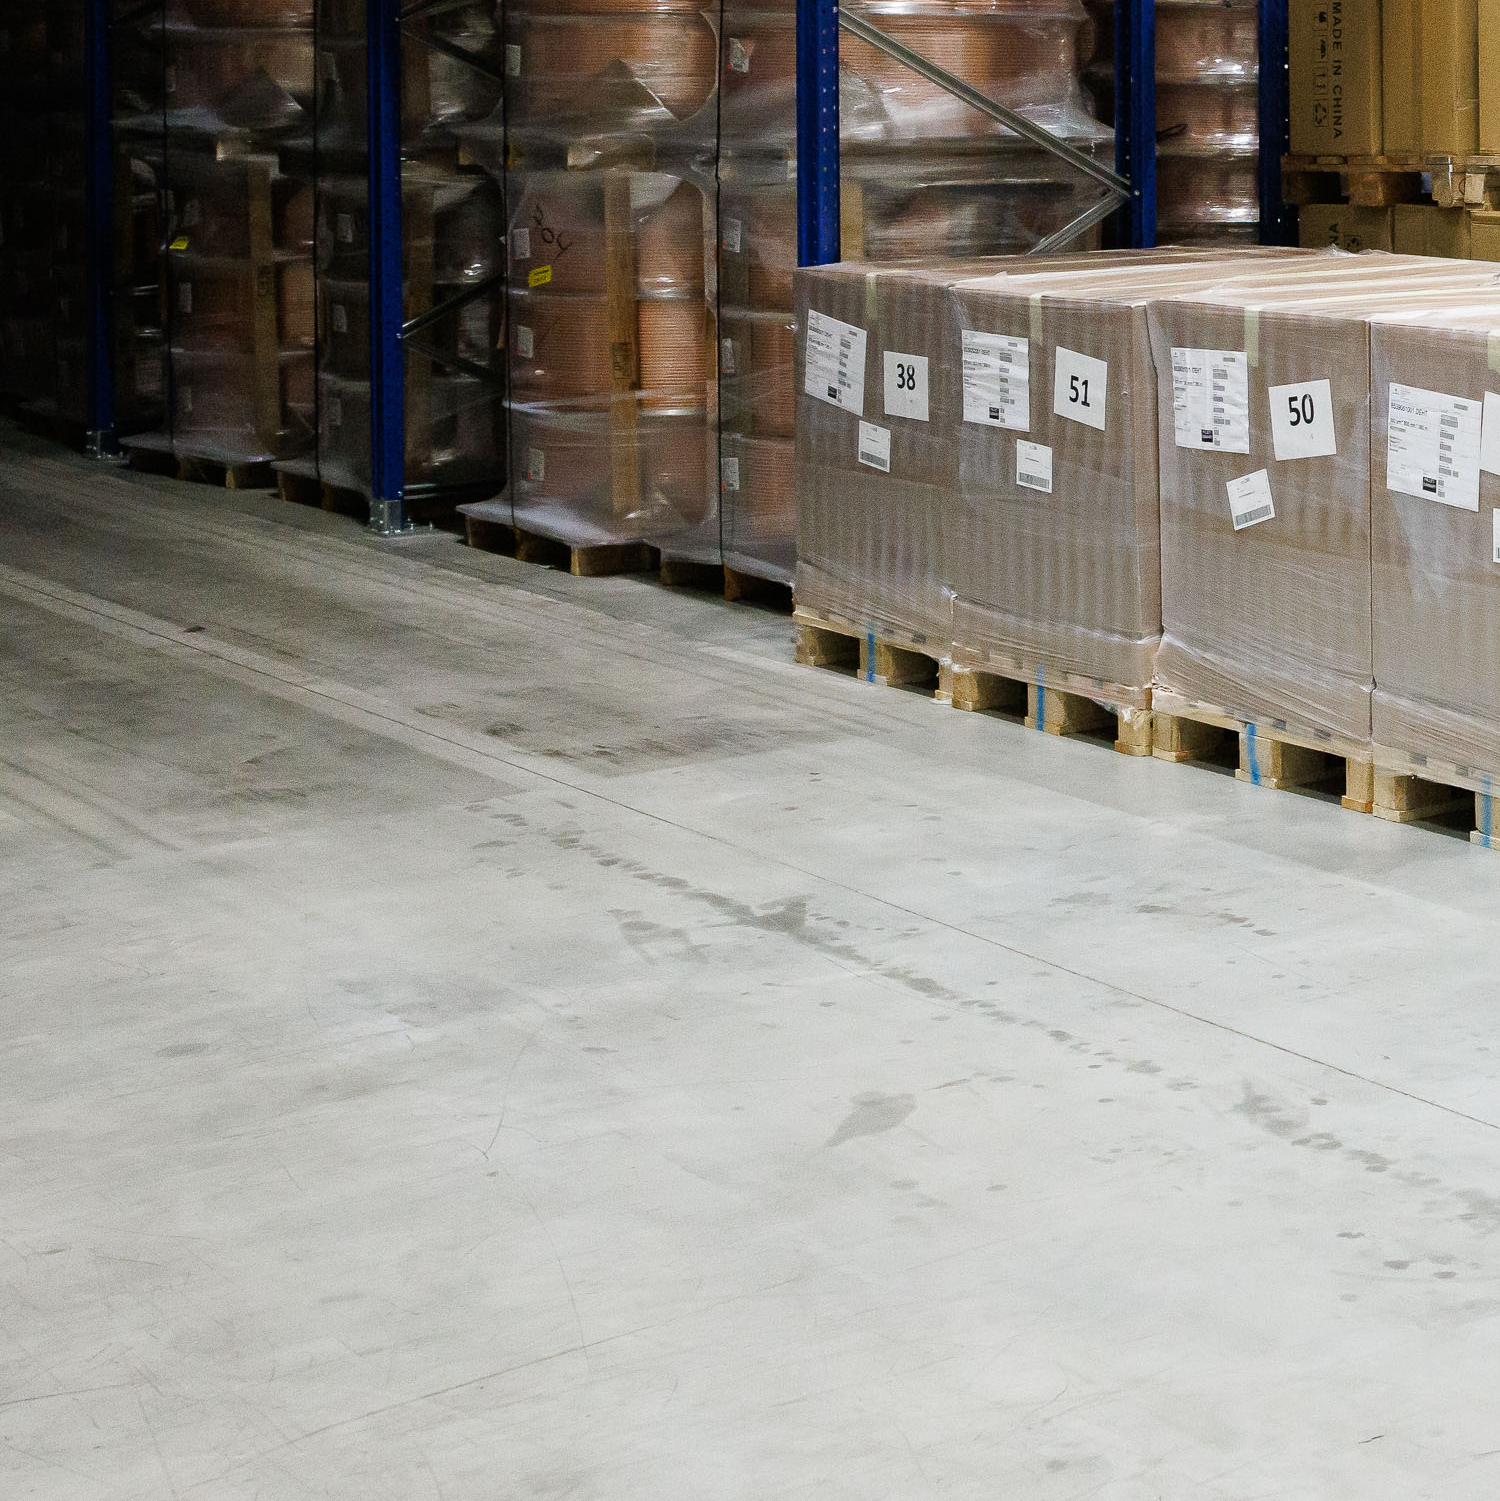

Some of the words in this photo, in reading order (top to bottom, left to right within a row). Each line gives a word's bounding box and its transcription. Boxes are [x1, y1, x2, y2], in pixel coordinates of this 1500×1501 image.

[1332, 2, 1342, 50] MADE
[1332, 60, 1342, 76] IN
[1332, 85, 1342, 139] CHINA
[896, 363, 916, 391] 38
[1068, 375, 1090, 407] 51
[1288, 393, 1315, 426] 50
